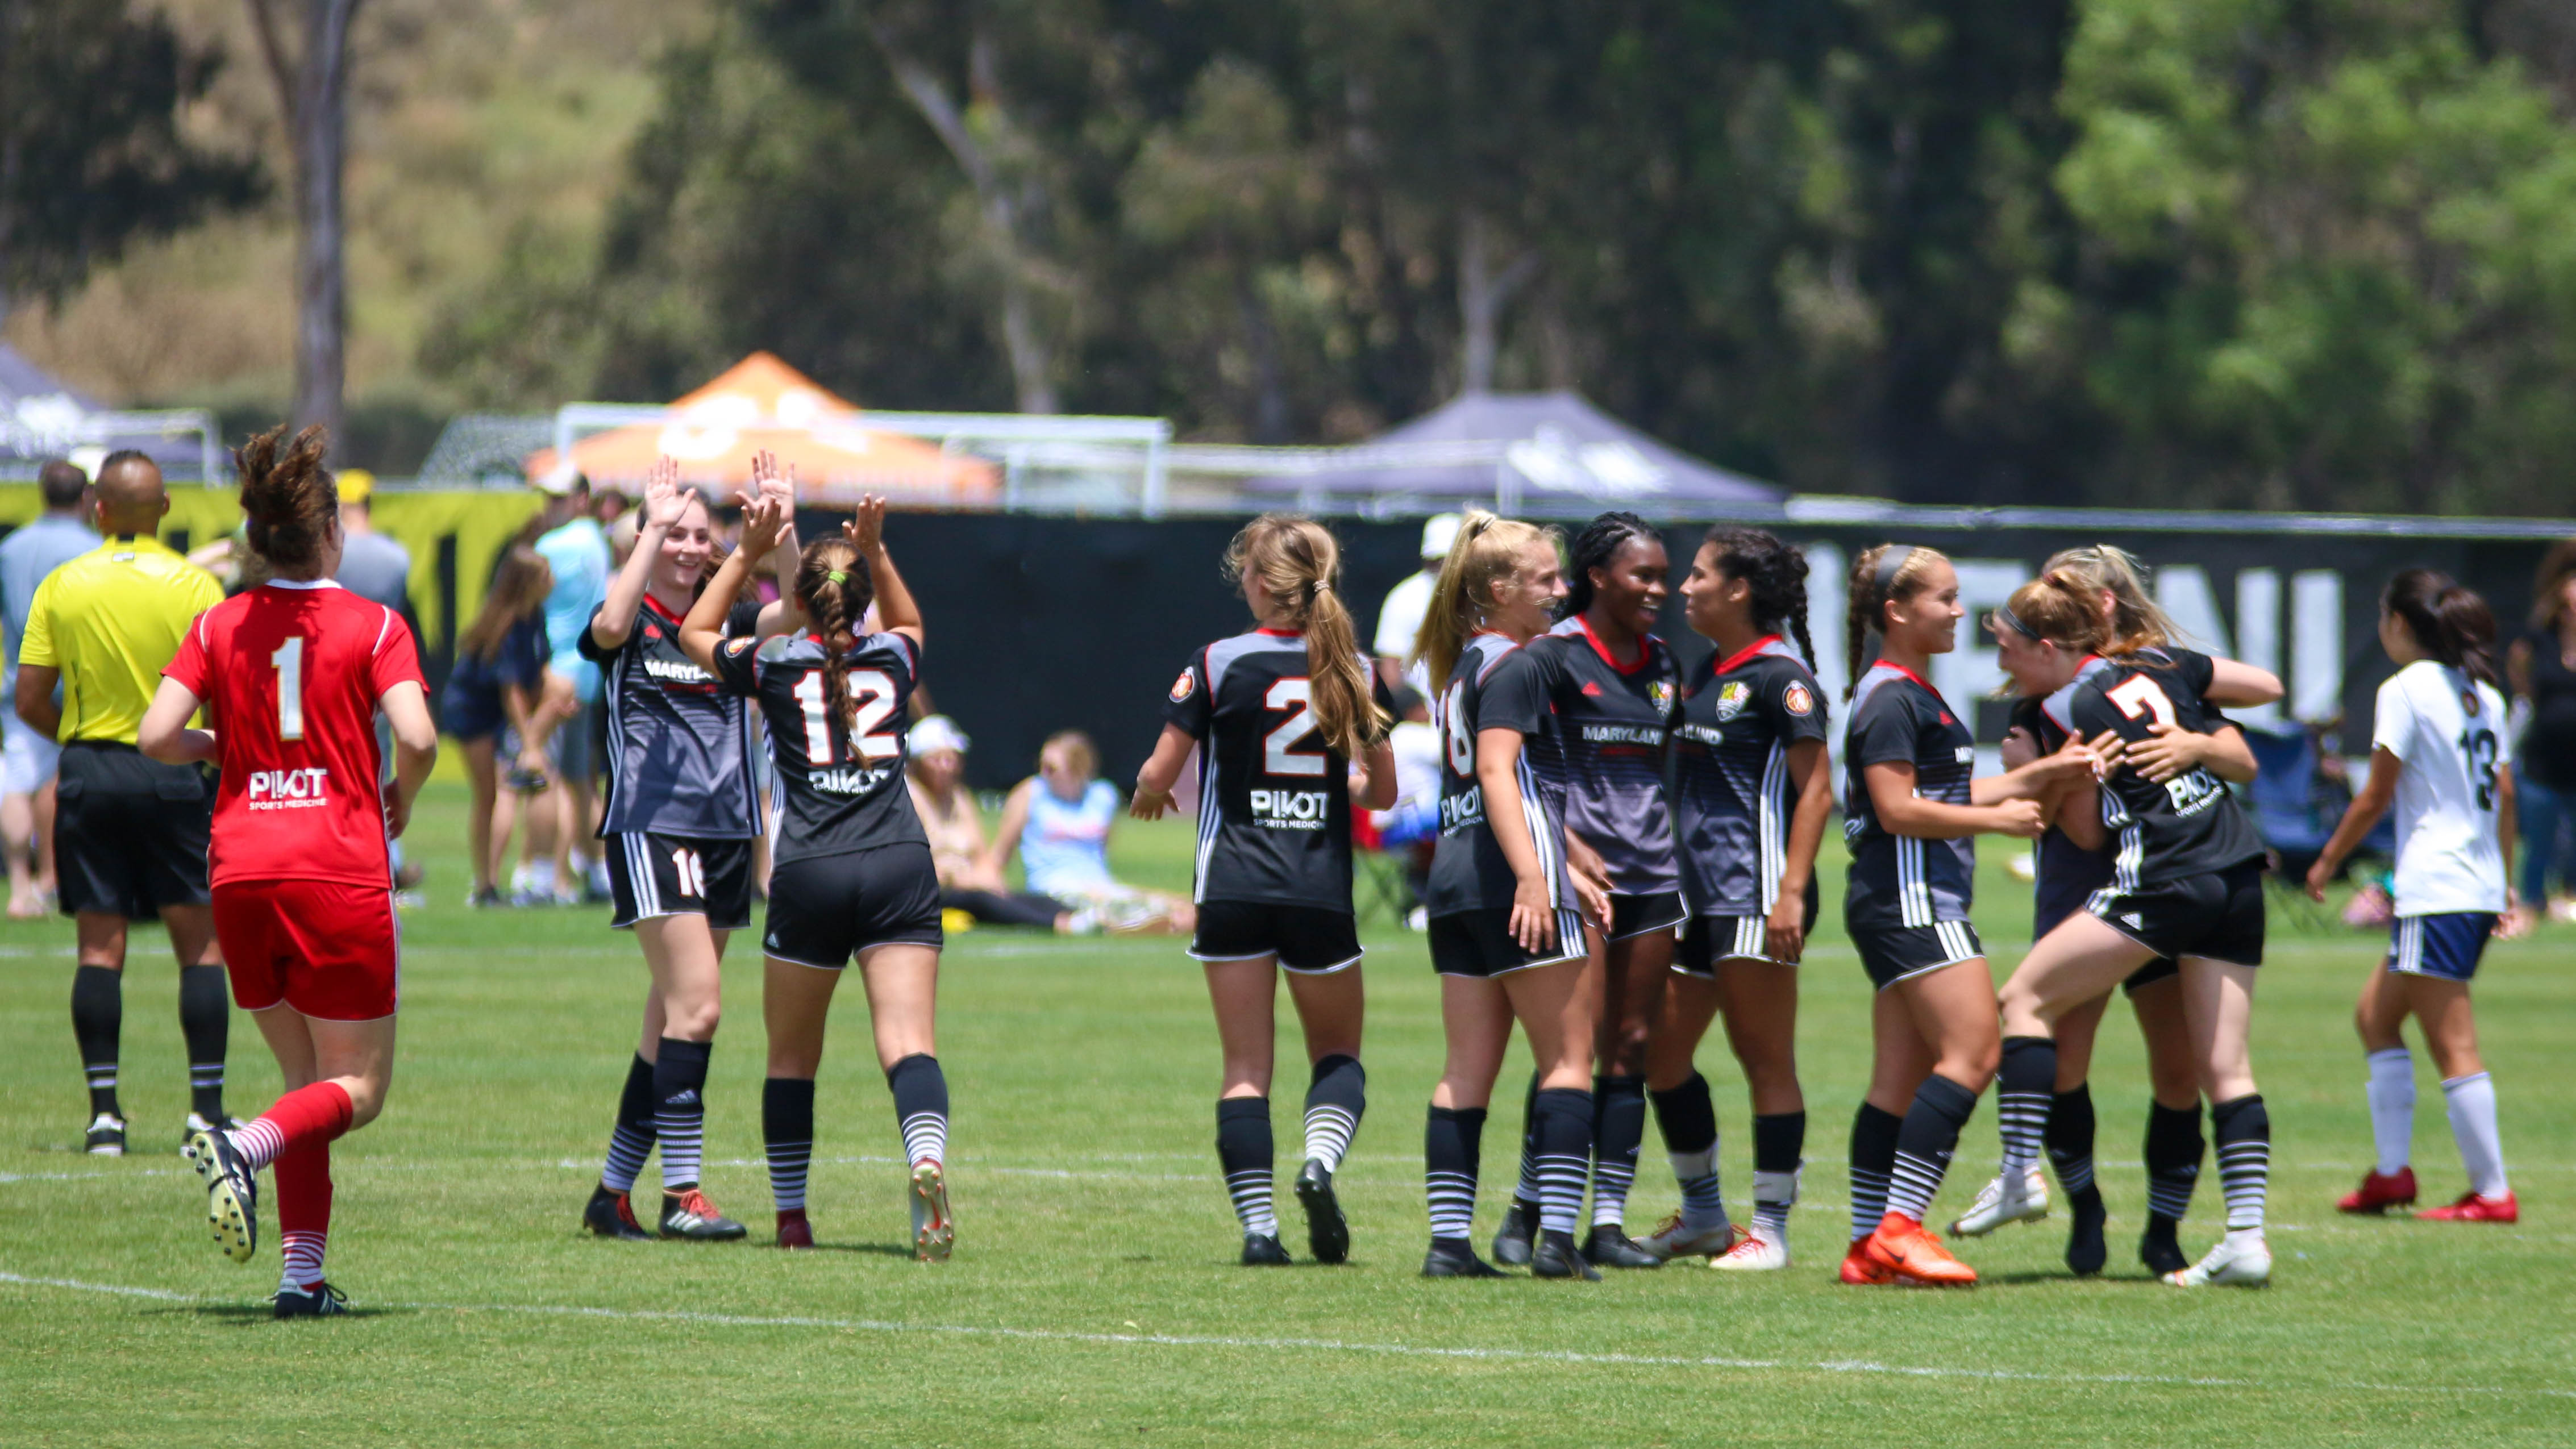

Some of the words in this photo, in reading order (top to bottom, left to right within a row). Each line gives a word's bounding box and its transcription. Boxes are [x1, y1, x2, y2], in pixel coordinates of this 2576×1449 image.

[271, 636, 303, 742] 1
[792, 667, 900, 766] 12
[2105, 672, 2178, 726] 7
[1263, 676, 1327, 777] 2
[249, 768, 327, 799] PIVOT
[1250, 790, 1327, 819] PIVOT
[2458, 728, 2496, 812] 13
[1254, 819, 1286, 828] SPORTS
